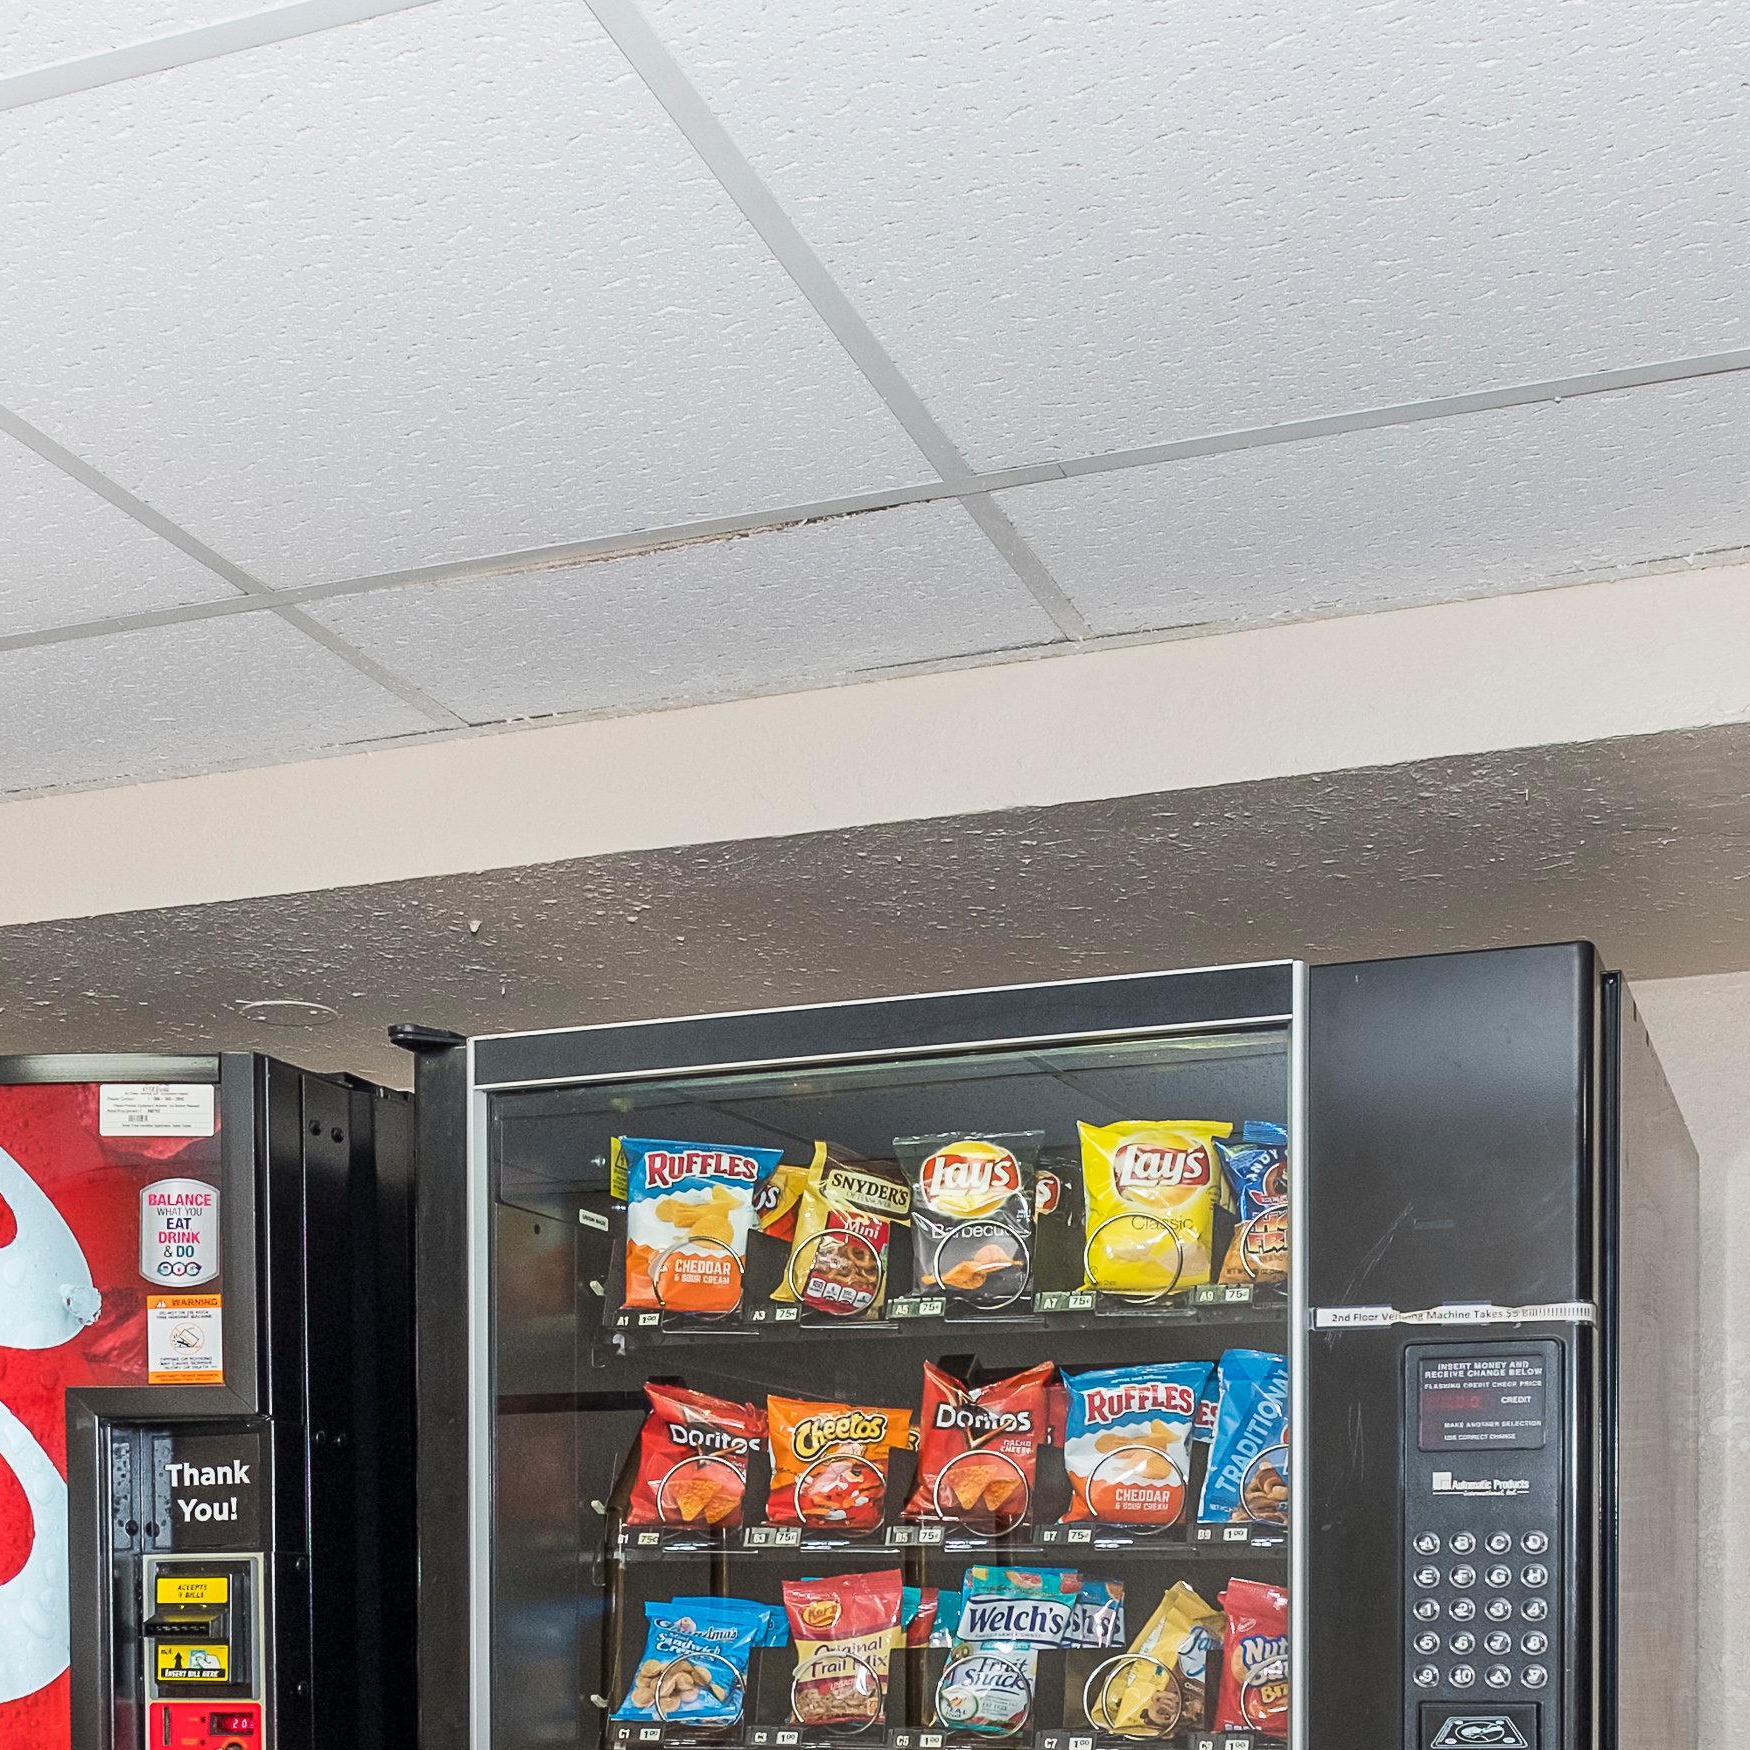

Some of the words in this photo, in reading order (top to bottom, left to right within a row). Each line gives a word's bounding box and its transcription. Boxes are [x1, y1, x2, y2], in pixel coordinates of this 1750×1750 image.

[645, 1151, 758, 1188] RUFFLES
[1120, 1145, 1204, 1187] Lay's
[930, 1156, 1012, 1199] Lay's
[831, 1173, 908, 1207] SNYDER'S
[148, 1194, 211, 1206] BALANCE
[157, 1207, 181, 1216] WHAT
[185, 1207, 202, 1216] YOU
[167, 1218, 191, 1229] EAT
[847, 1220, 880, 1240] Mini
[158, 1232, 200, 1244] DRINK
[164, 1245, 172, 1257] &
[177, 1245, 194, 1257] DO
[674, 1259, 731, 1275] CHEDDAR
[681, 1275, 701, 1283] SOUR
[703, 1275, 730, 1284] CREAM
[172, 1298, 217, 1306] WARNING
[1332, 1314, 1350, 1323] 2nd
[1353, 1313, 1378, 1322] Floor
[1426, 1309, 1471, 1320] Machine
[1474, 1309, 1503, 1319] Takes
[1438, 1362, 1471, 1370] INSERT
[1474, 1361, 1507, 1370] MONEY
[1424, 1370, 1464, 1379] RECEIVE
[1467, 1369, 1505, 1377] CHANGE
[1509, 1368, 1543, 1376] BELOW
[1086, 1384, 1194, 1424] RUFFLES
[1501, 1396, 1531, 1404] CREDIT
[936, 1404, 1031, 1433] Doritos
[669, 1424, 761, 1454] Doritos
[794, 1411, 886, 1461] Cheetos
[164, 1460, 250, 1487] Thank
[1451, 1480, 1492, 1489] Automatic
[1493, 1479, 1529, 1489] Products
[1115, 1489, 1170, 1503] CHEDDAR
[177, 1497, 237, 1522] You!
[1122, 1502, 1141, 1510] SOUR
[1143, 1503, 1169, 1511] CREAM
[969, 1605, 1064, 1635] Welch's
[810, 1658, 846, 1678] Trail
